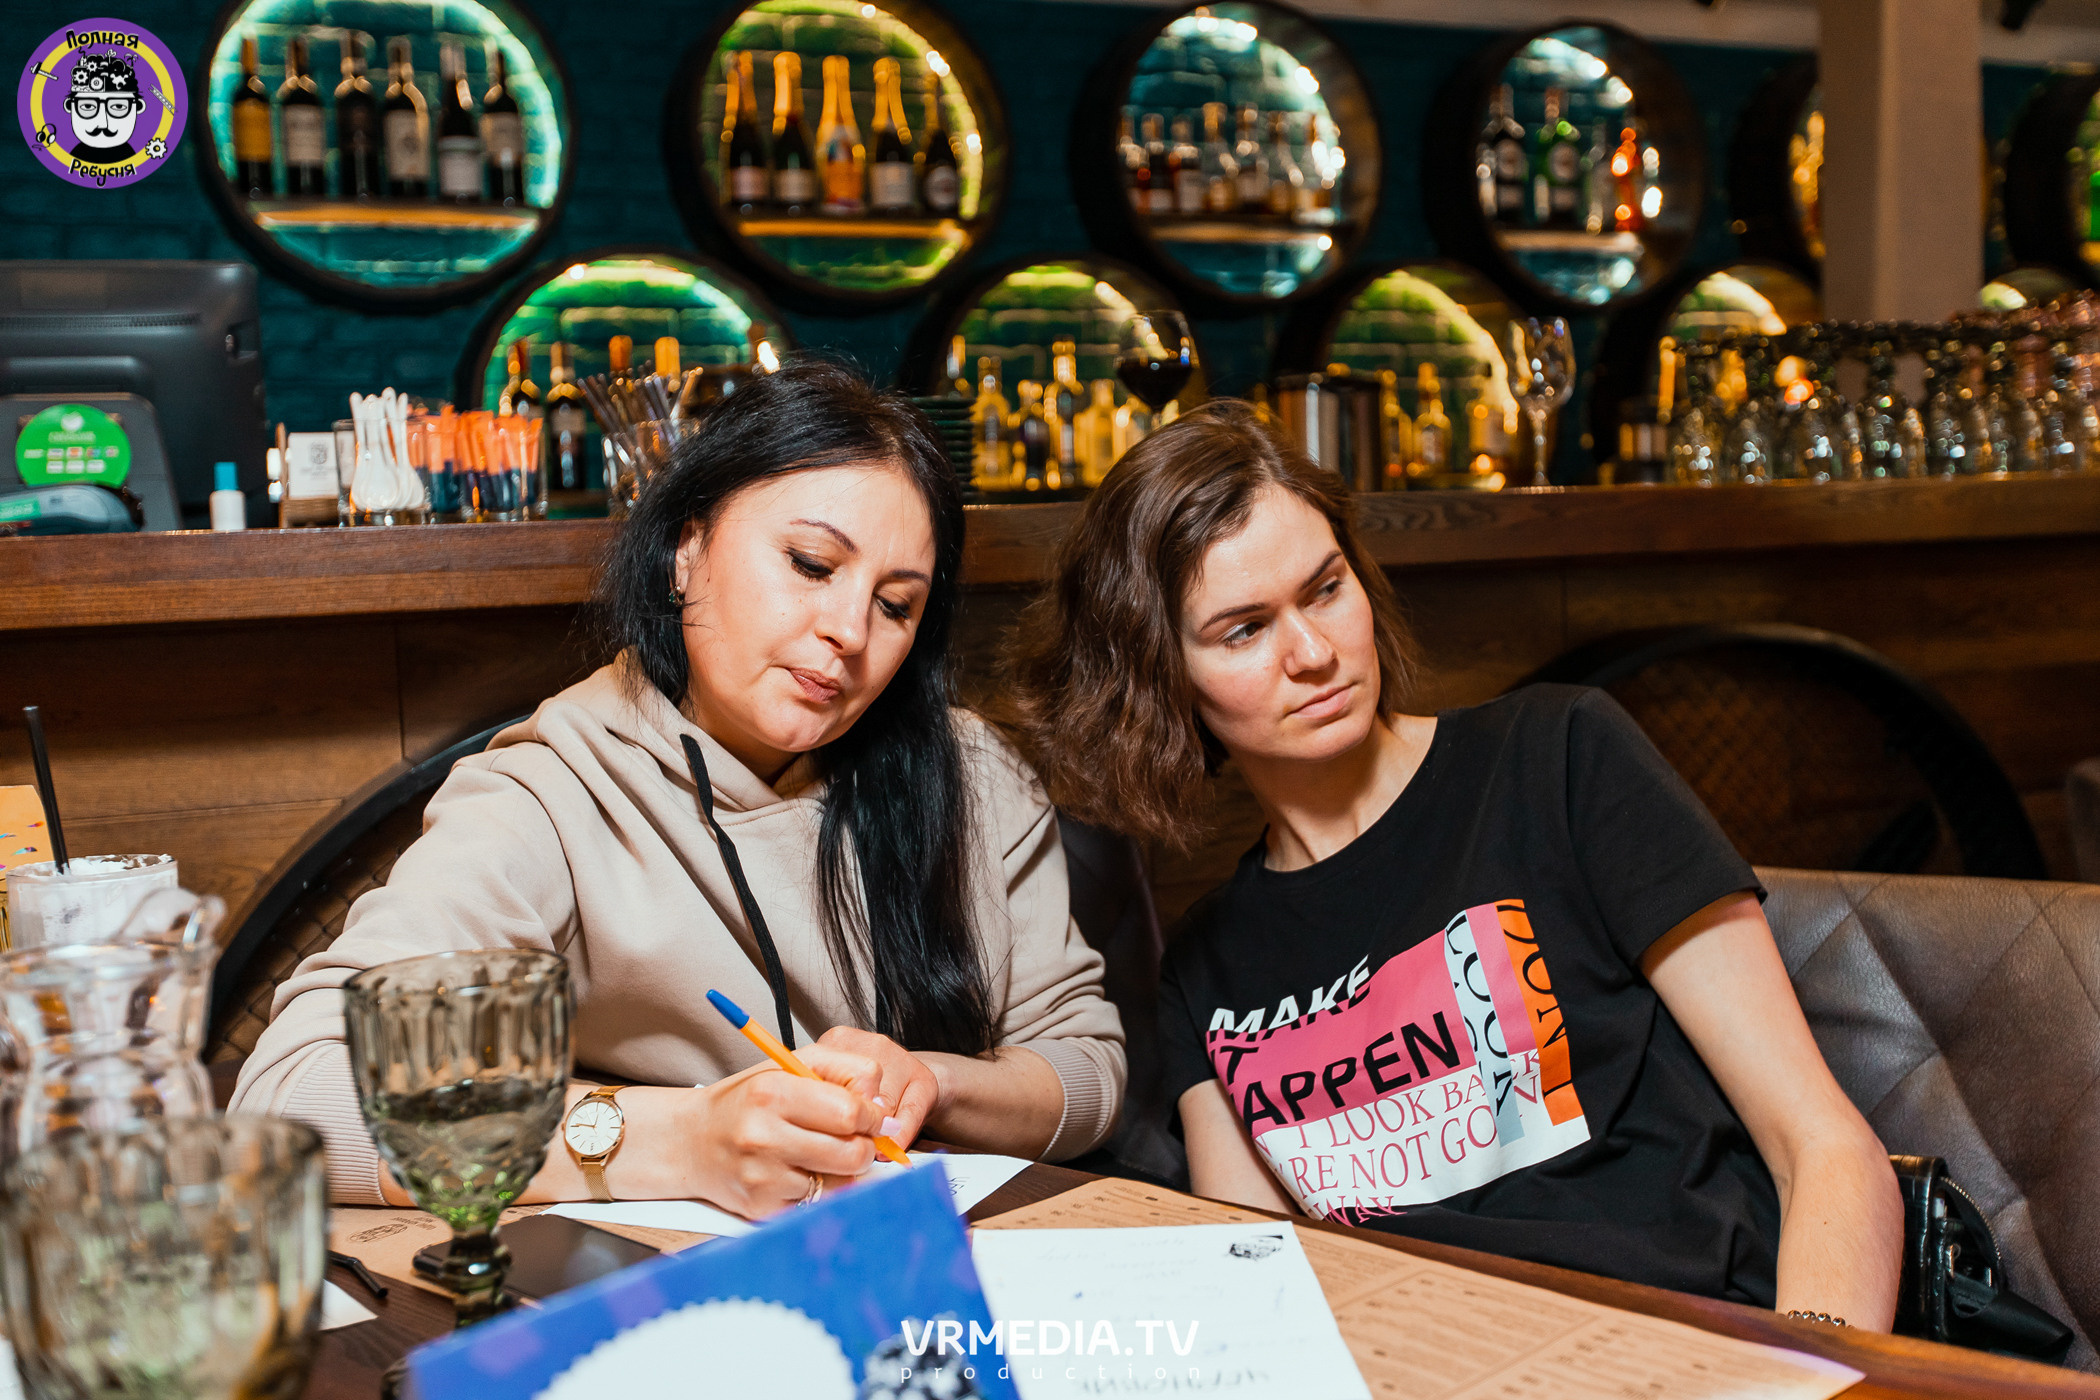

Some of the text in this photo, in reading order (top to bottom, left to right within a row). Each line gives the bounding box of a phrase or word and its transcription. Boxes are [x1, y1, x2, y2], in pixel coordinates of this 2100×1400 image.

[1208, 954, 1370, 1044] MAKE
[1231, 1011, 1461, 1136] APPEN
[1326, 1088, 1436, 1148] LOOK
[1349, 1130, 1432, 1190] NOT
